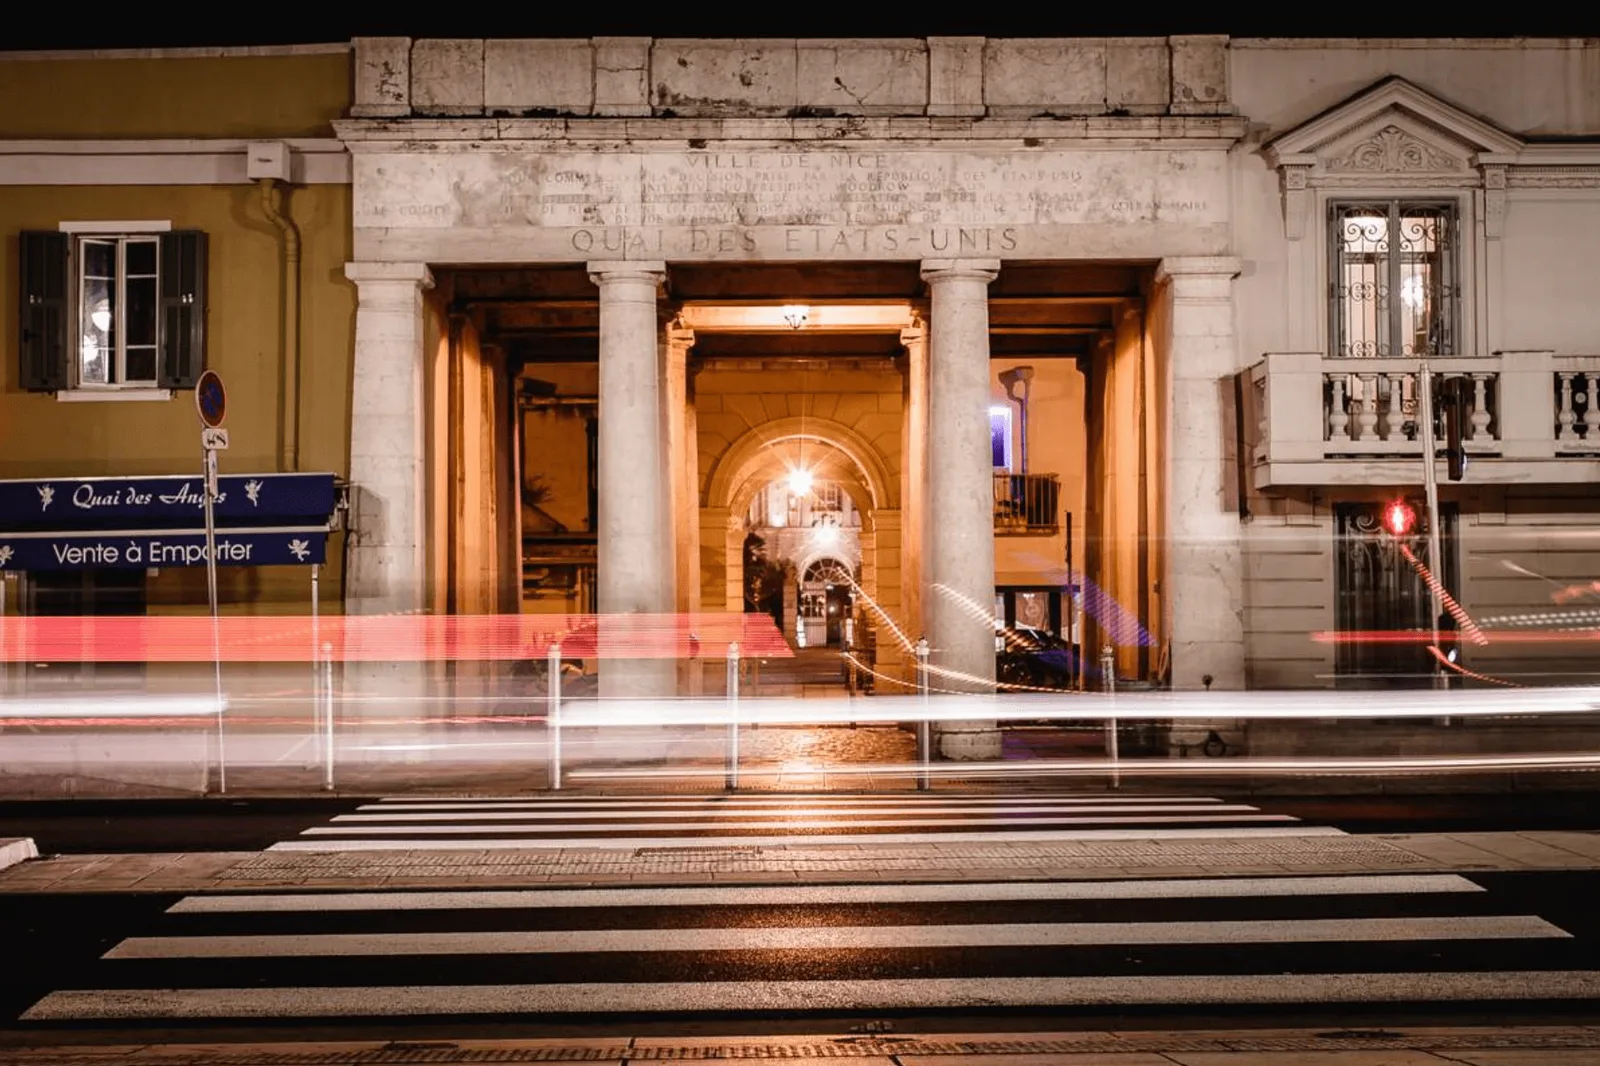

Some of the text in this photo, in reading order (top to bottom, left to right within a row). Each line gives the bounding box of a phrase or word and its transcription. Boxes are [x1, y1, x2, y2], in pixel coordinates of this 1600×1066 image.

[685, 154, 888, 168] VILLE DE NICE
[572, 228, 1017, 252] QUAI DES ETATS-UNIS
[72, 484, 121, 509] Quai
[125, 486, 153, 505] des
[53, 540, 253, 565] Vente à Emporter
